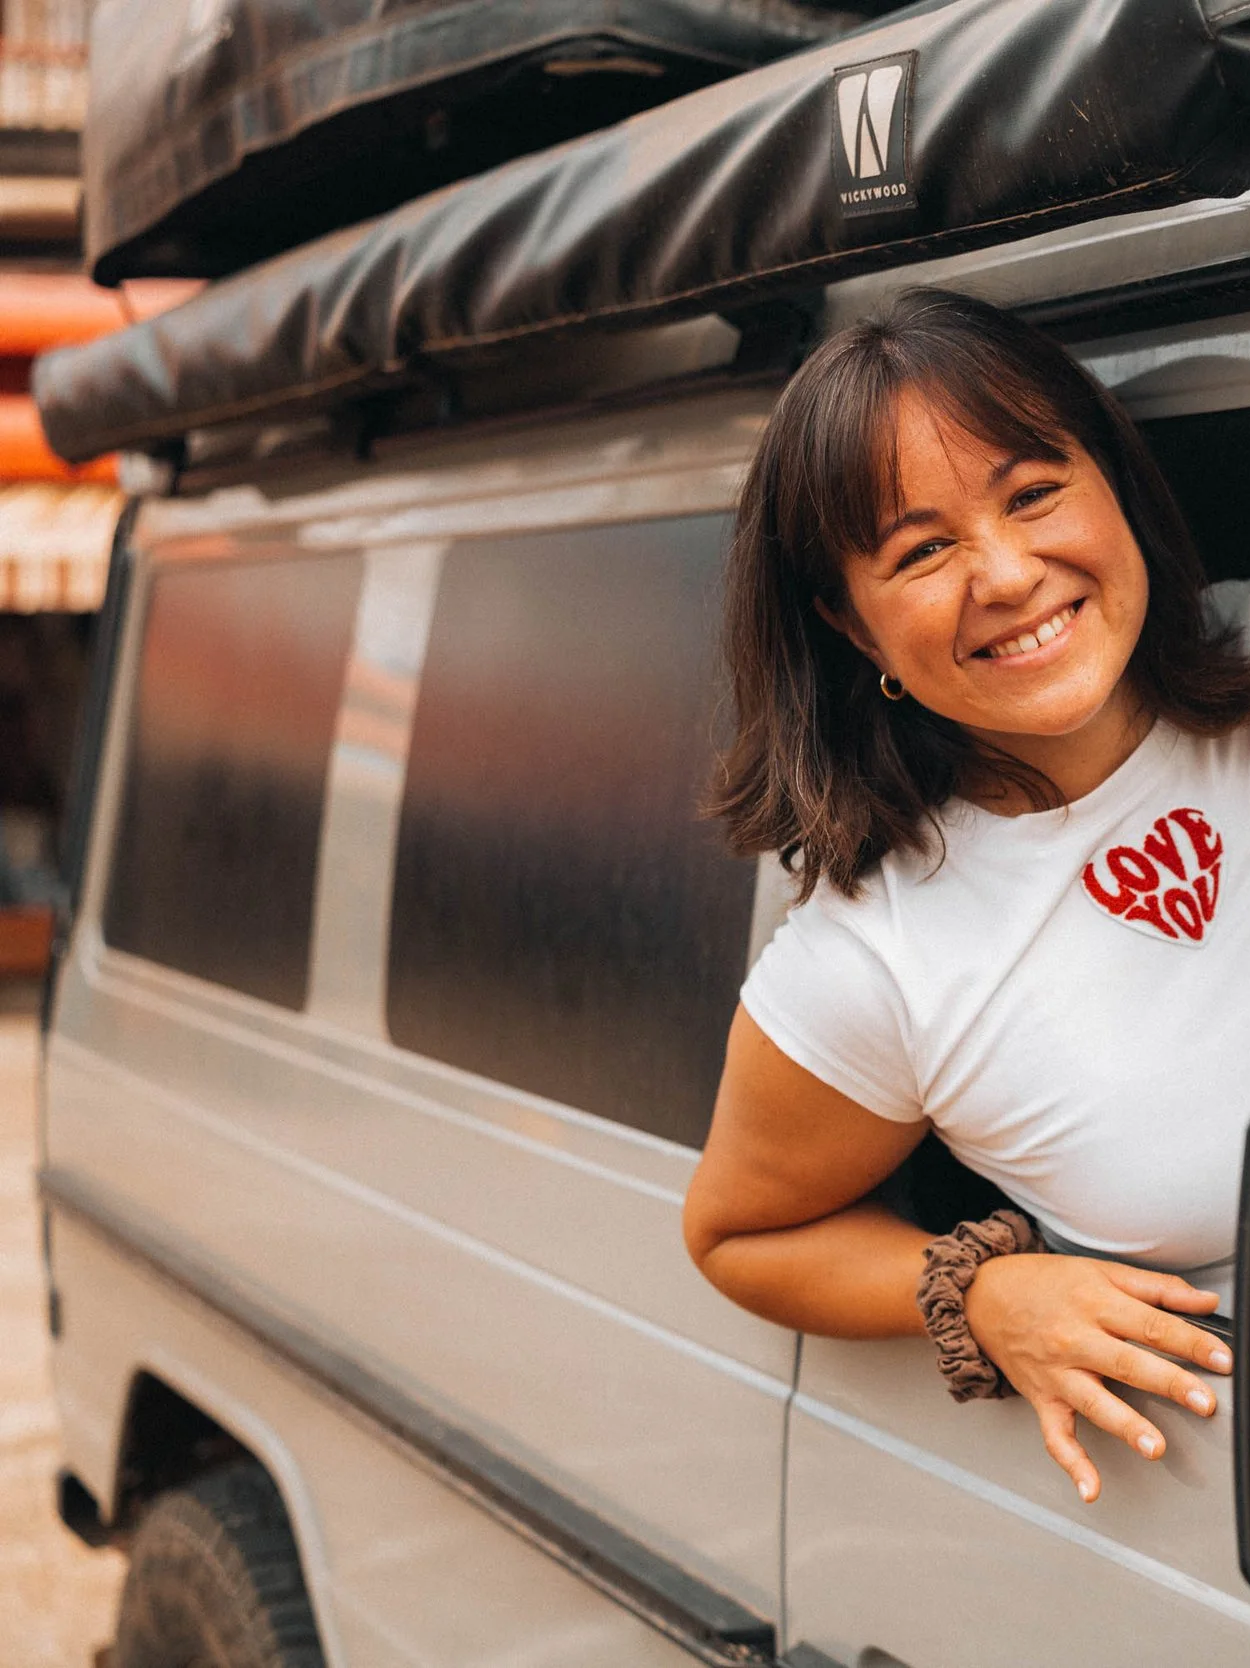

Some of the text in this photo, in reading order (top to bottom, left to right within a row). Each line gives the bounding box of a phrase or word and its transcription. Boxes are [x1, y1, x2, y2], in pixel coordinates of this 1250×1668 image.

[840, 183, 907, 204] VICKYWOOD
[1082, 808, 1223, 916] LOVE
[1125, 862, 1221, 941] YOU
